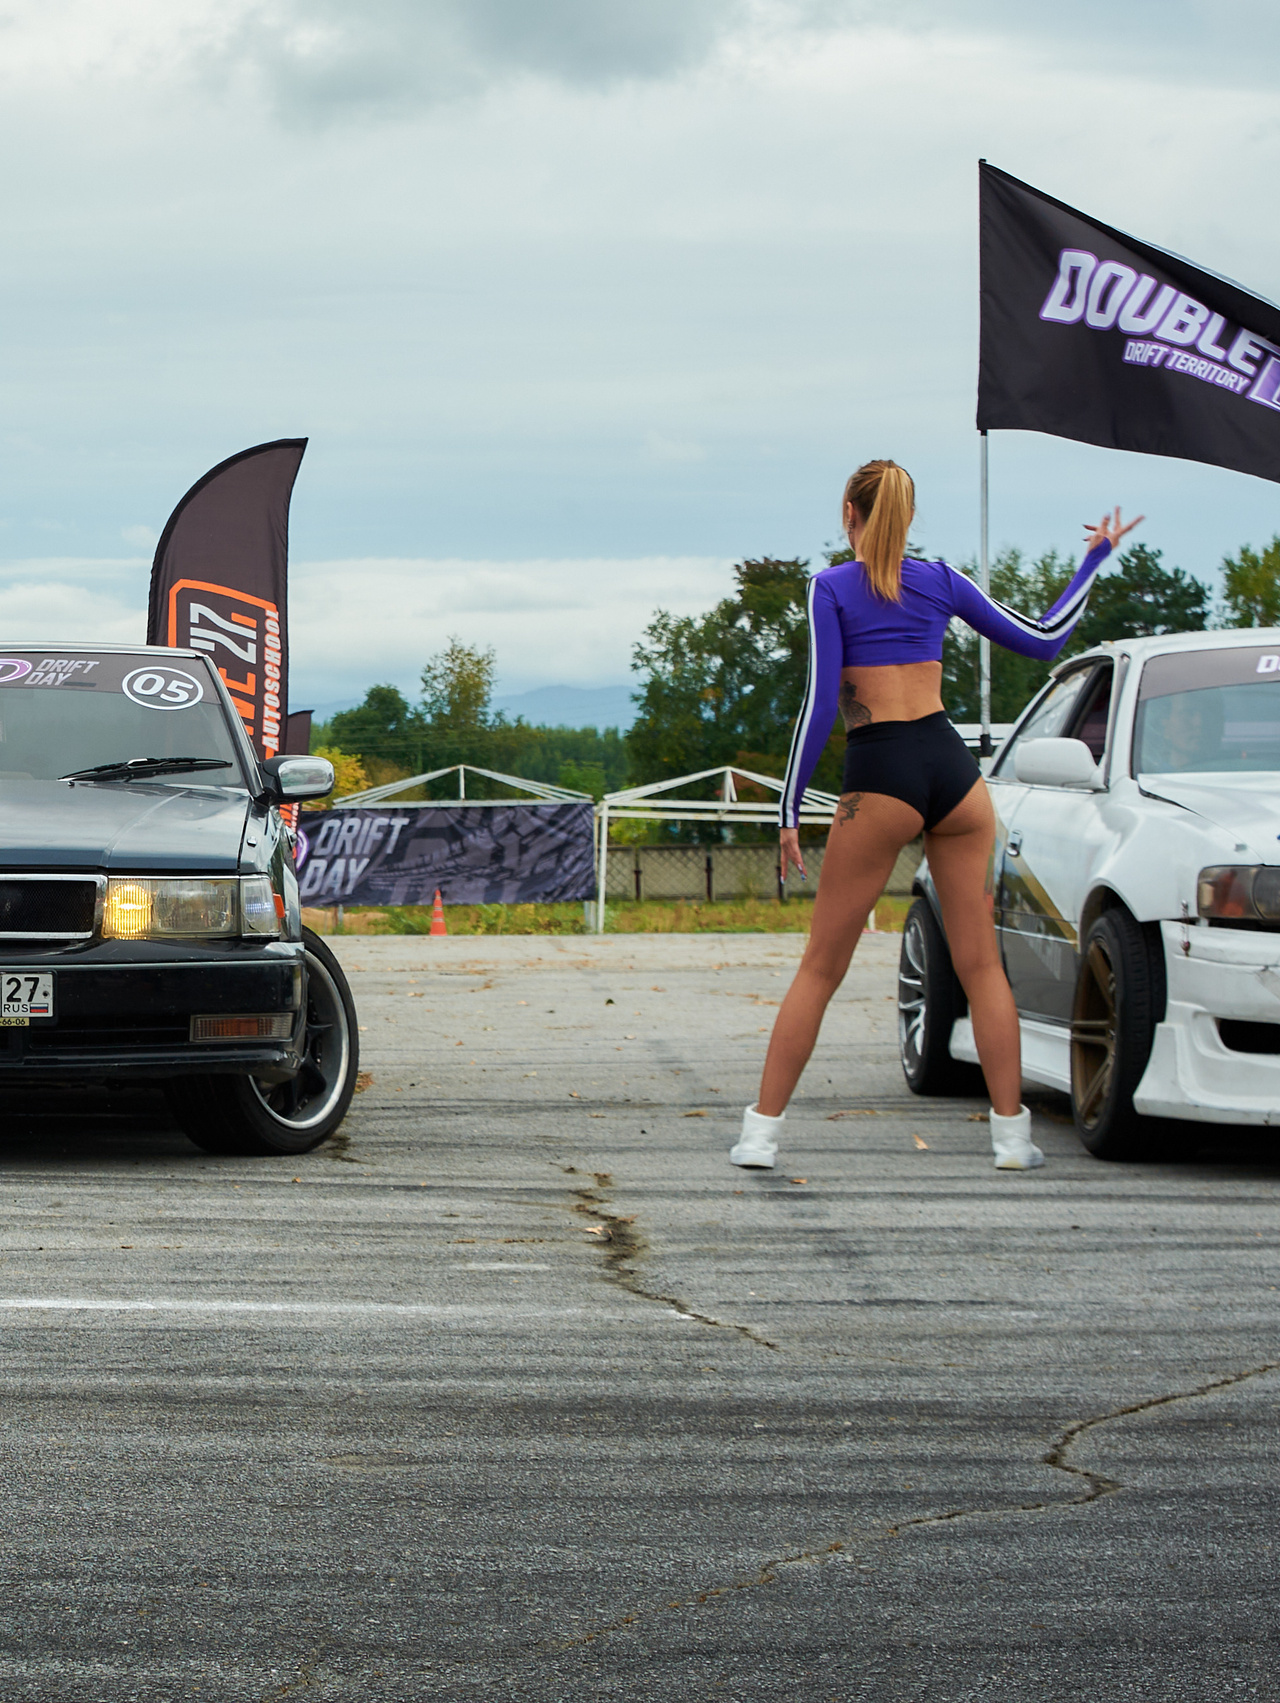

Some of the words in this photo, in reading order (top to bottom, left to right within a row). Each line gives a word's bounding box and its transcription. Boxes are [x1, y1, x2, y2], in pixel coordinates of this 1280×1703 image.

[1039, 248, 1265, 377] DOUBLE
[1123, 339, 1169, 366] DRIFT
[1166, 350, 1251, 394] TERRITORY
[23, 671, 72, 686] DAY
[35, 658, 100, 674] DRIFT
[262, 607, 282, 752] AUTOSCHOOL
[132, 673, 194, 703] 05
[311, 817, 410, 857] DRIFT
[299, 856, 370, 897] DAY
[6, 977, 40, 1003] 27
[3, 1003, 29, 1013] RUS
